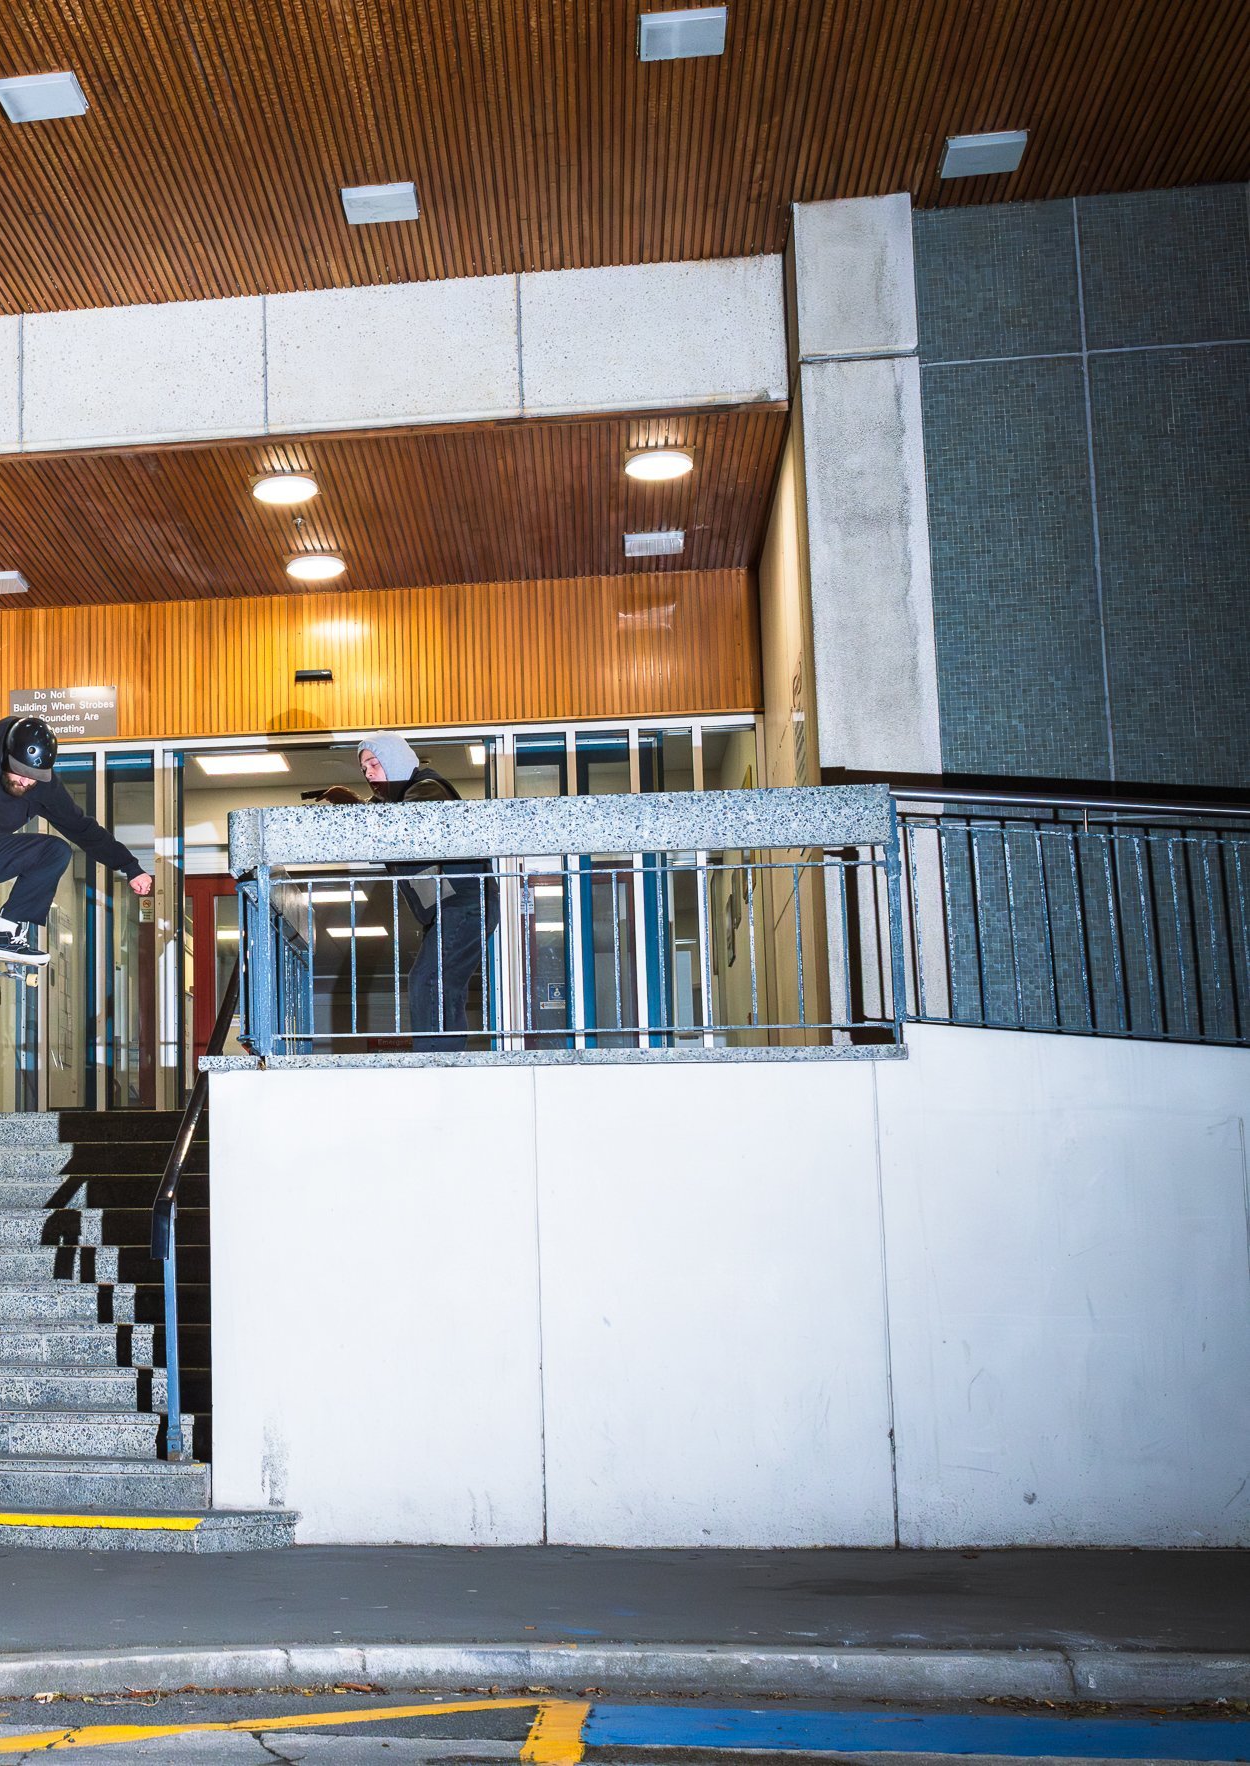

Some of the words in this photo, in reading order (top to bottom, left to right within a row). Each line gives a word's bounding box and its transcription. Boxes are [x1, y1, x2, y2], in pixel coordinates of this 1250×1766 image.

[34, 691, 46, 700] Do
[50, 690, 65, 699] Not
[13, 703, 47, 713] Building
[51, 702, 75, 710] When
[79, 700, 114, 709] Strobes
[39, 713, 80, 722] Sounders
[84, 713, 99, 721] Are
[52, 725, 85, 735] erating
